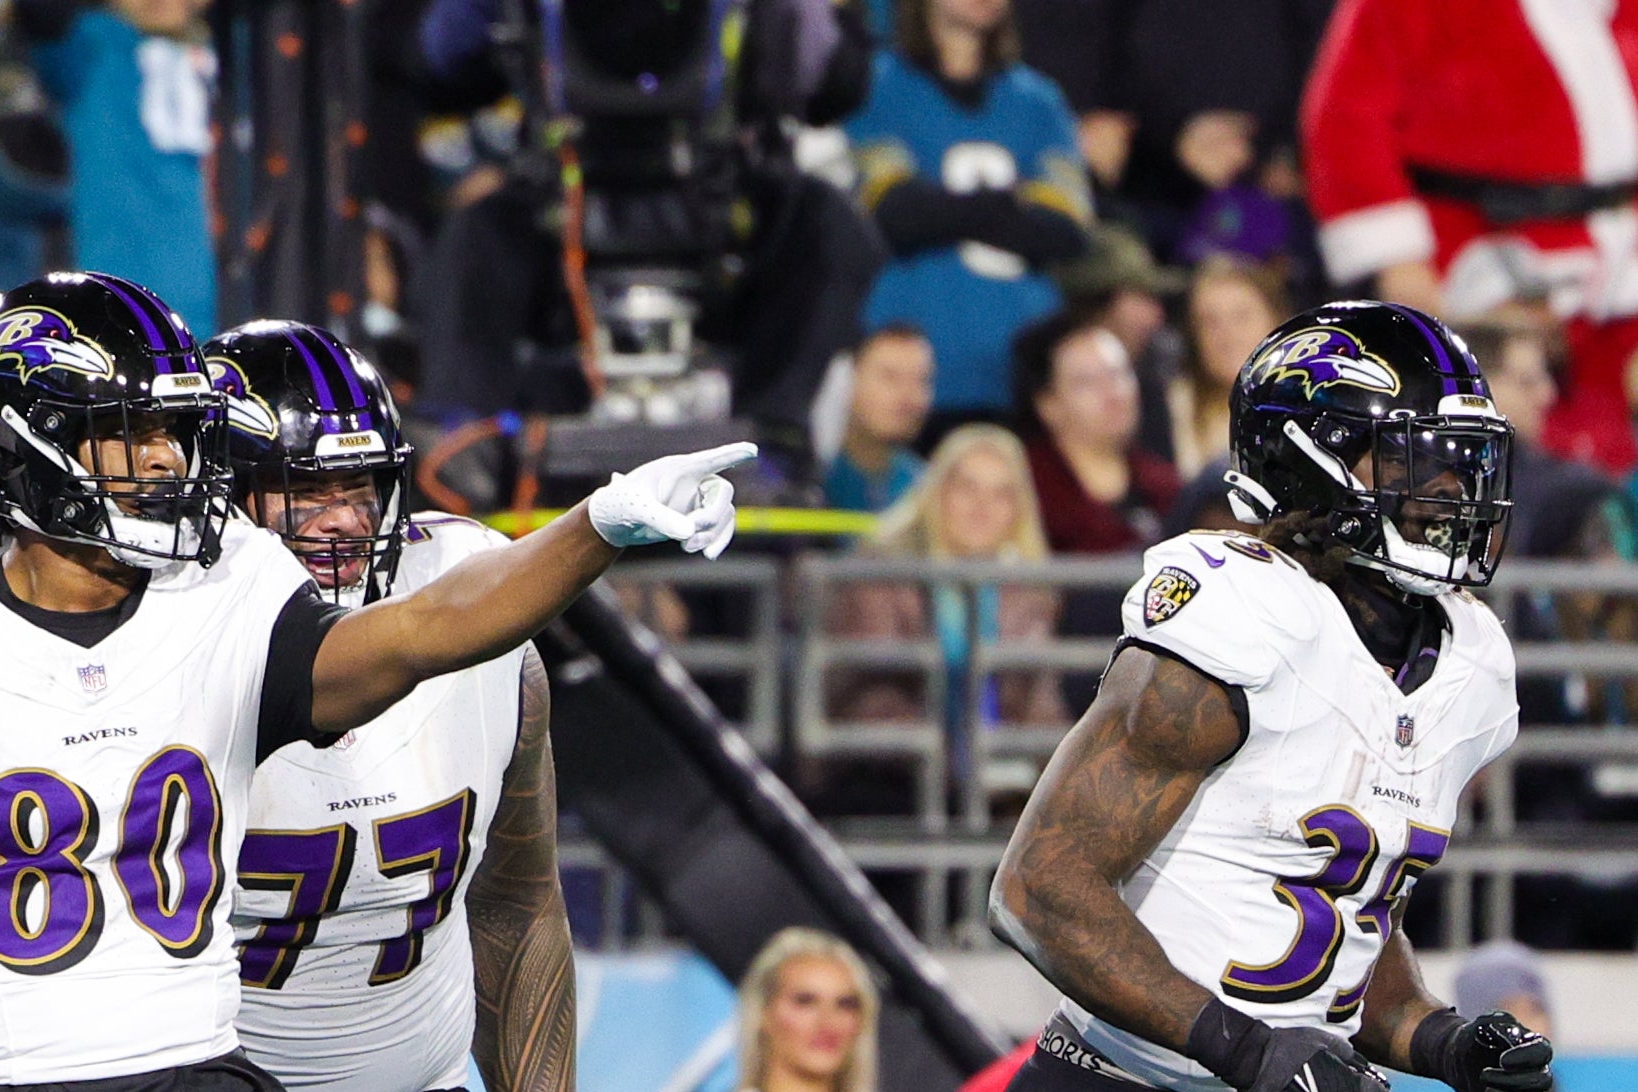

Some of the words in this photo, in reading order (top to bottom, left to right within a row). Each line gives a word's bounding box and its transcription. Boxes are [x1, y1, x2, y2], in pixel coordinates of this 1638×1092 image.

[337, 434, 372, 448] RAVENS
[61, 726, 139, 746] RAVENS
[327, 791, 398, 812] RAVENS
[1371, 785, 1422, 808] RAVENS
[237, 787, 477, 991] 77
